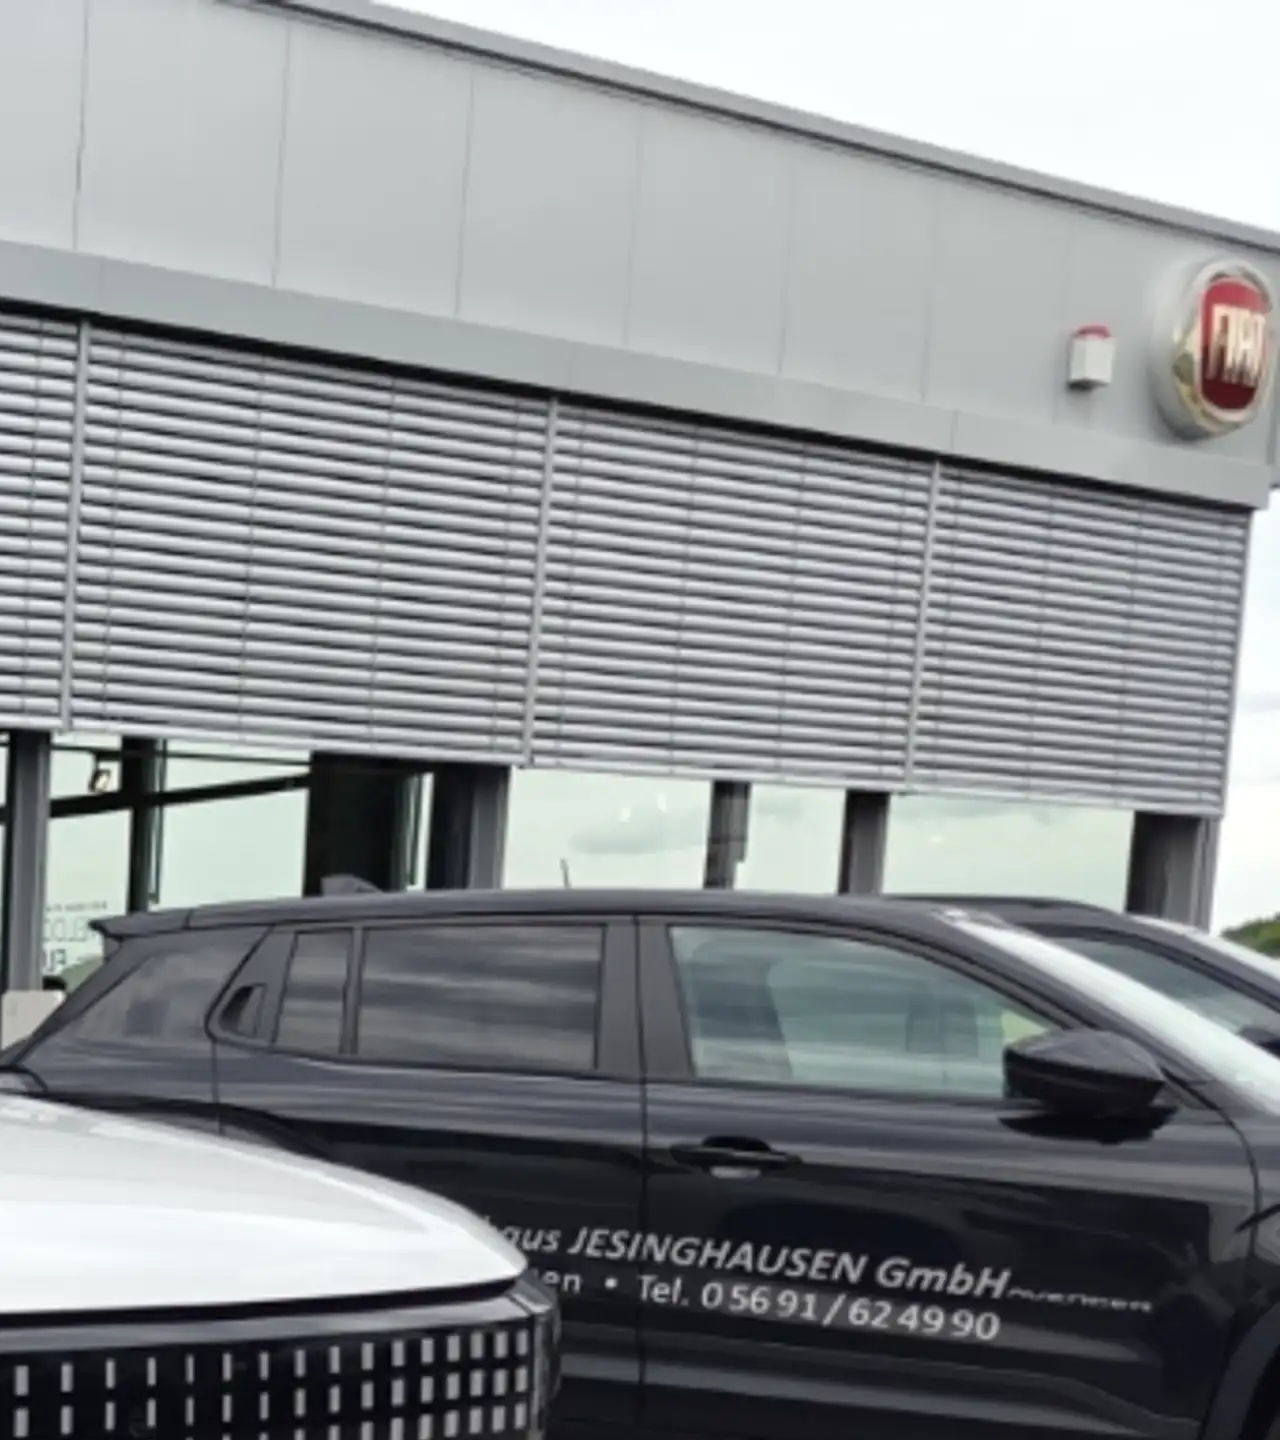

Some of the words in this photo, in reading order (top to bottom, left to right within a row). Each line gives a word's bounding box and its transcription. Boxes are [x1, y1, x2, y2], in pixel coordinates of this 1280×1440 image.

[486, 1217, 561, 1251] aus
[567, 1226, 868, 1284] JESINGHAUSEN
[875, 1256, 1011, 1299] GmbH
[637, 1274, 689, 1306] Tel.
